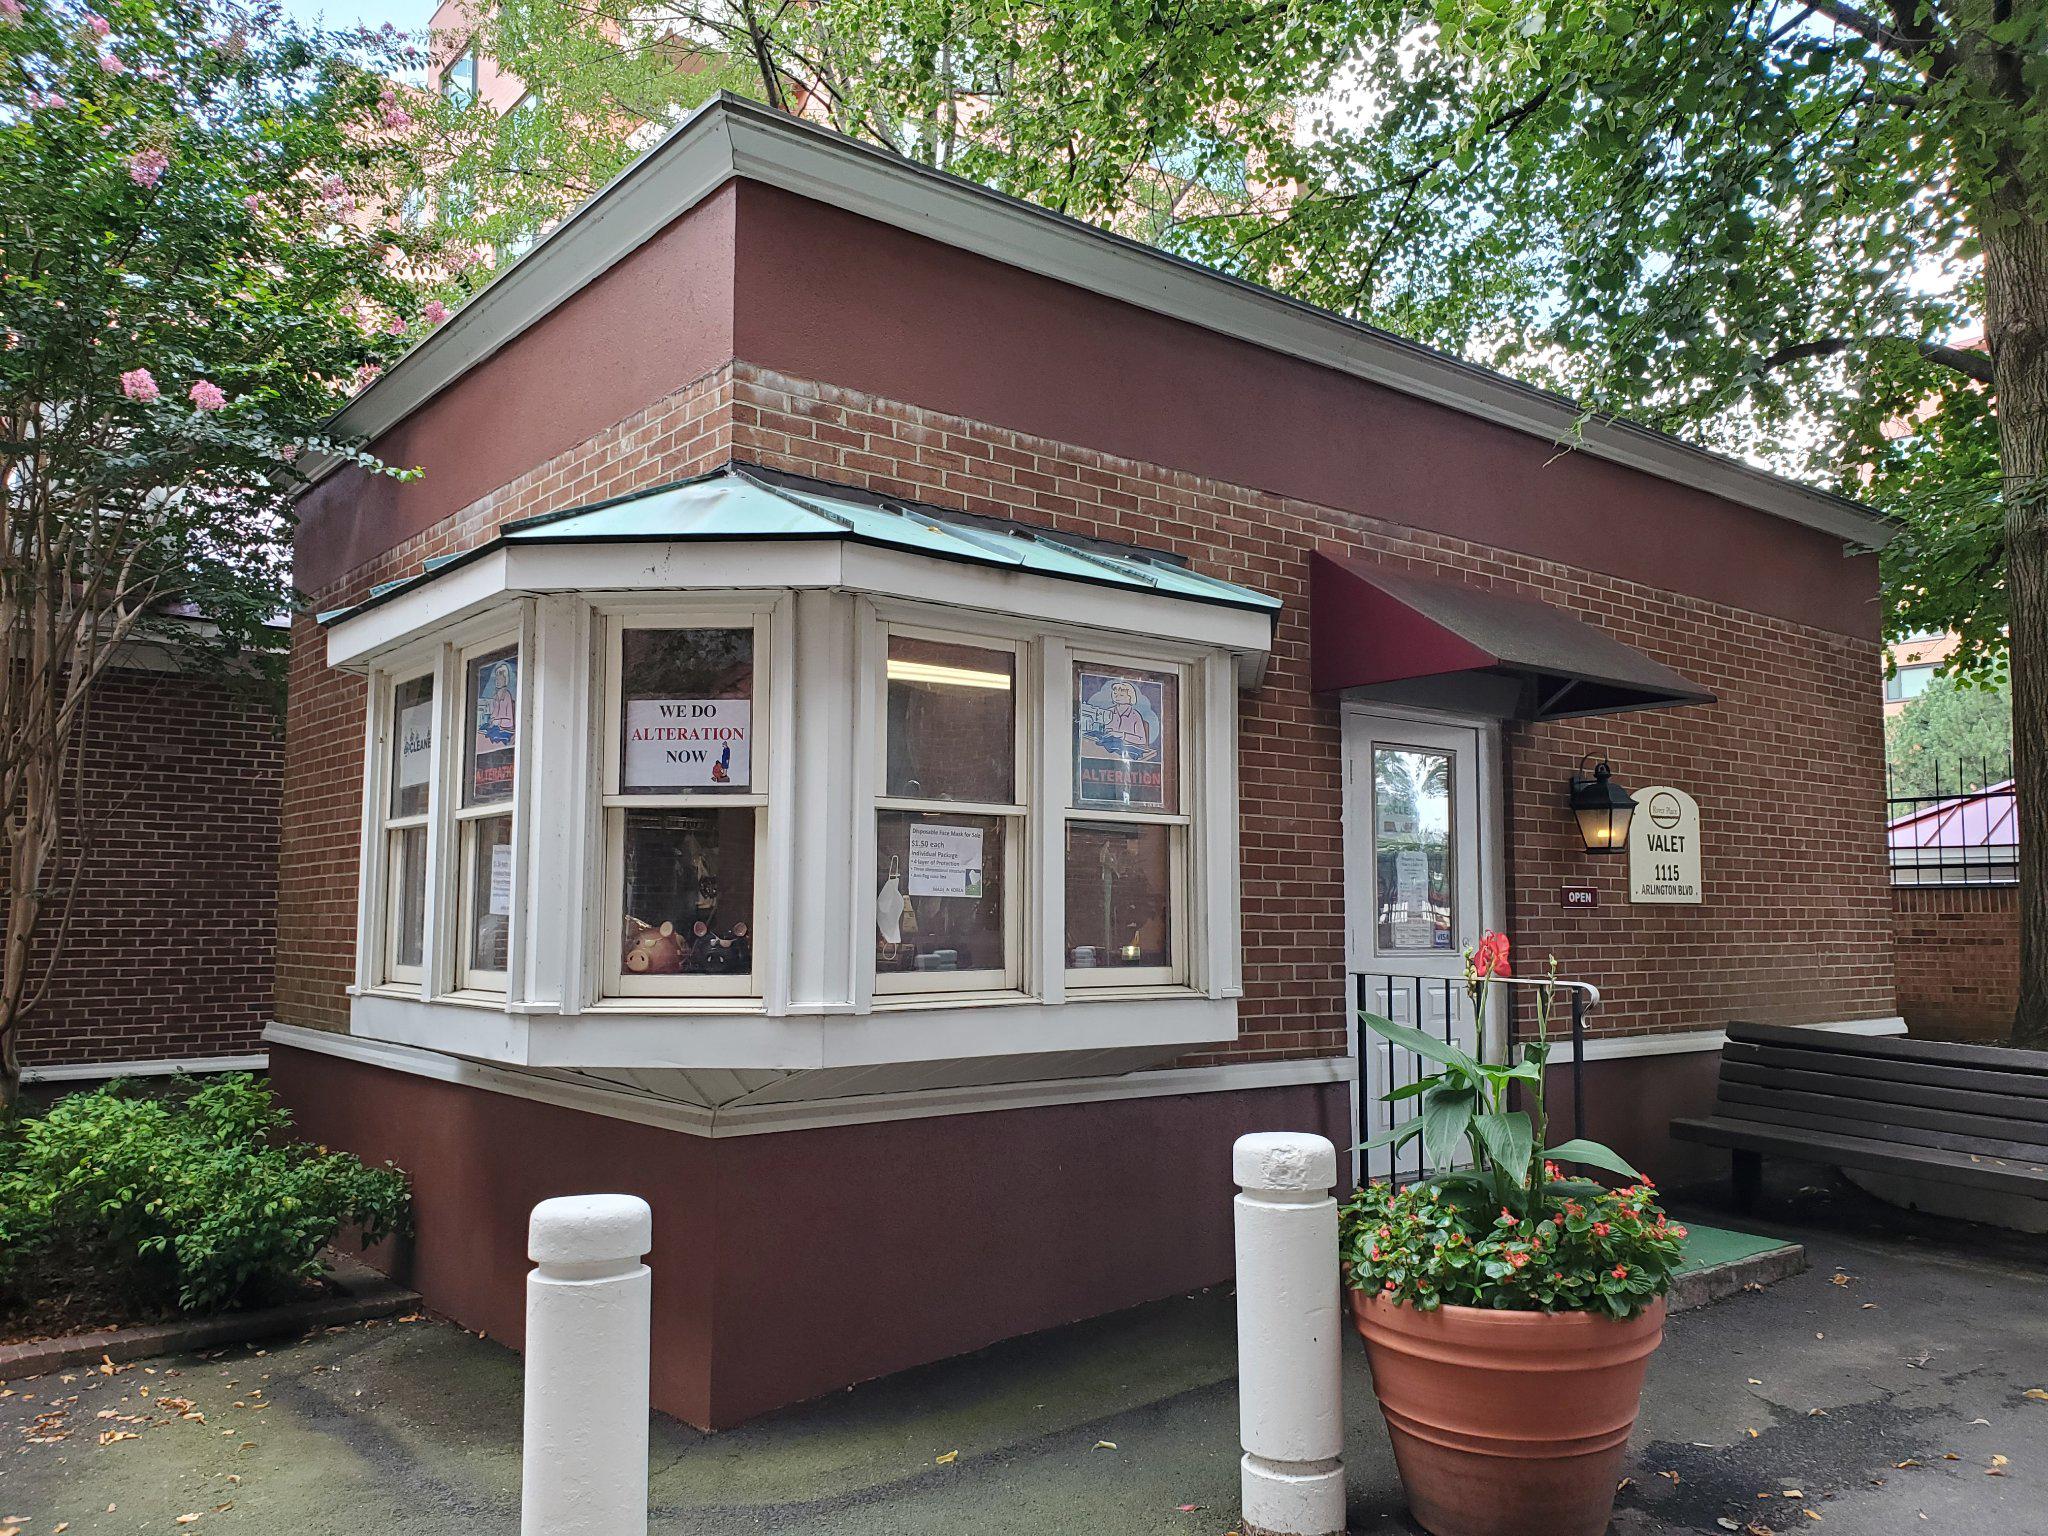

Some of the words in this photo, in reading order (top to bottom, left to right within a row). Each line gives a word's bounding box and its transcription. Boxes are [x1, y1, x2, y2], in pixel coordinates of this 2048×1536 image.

[660, 704, 687, 718] WE
[692, 704, 717, 718] DO
[632, 727, 745, 741] ALTERATION
[666, 750, 708, 763] NOW
[1081, 768, 1161, 785] ALTERATION
[912, 828, 939, 837] Disposable
[1647, 833, 1685, 853] VALET
[937, 851, 958, 859] Package
[1654, 864, 1680, 881] 1115
[1641, 884, 1677, 896] ARLINGTON
[1678, 885, 1693, 896] BLVD
[1568, 892, 1592, 903] OPEN
[1437, 933, 1449, 941] VISA
